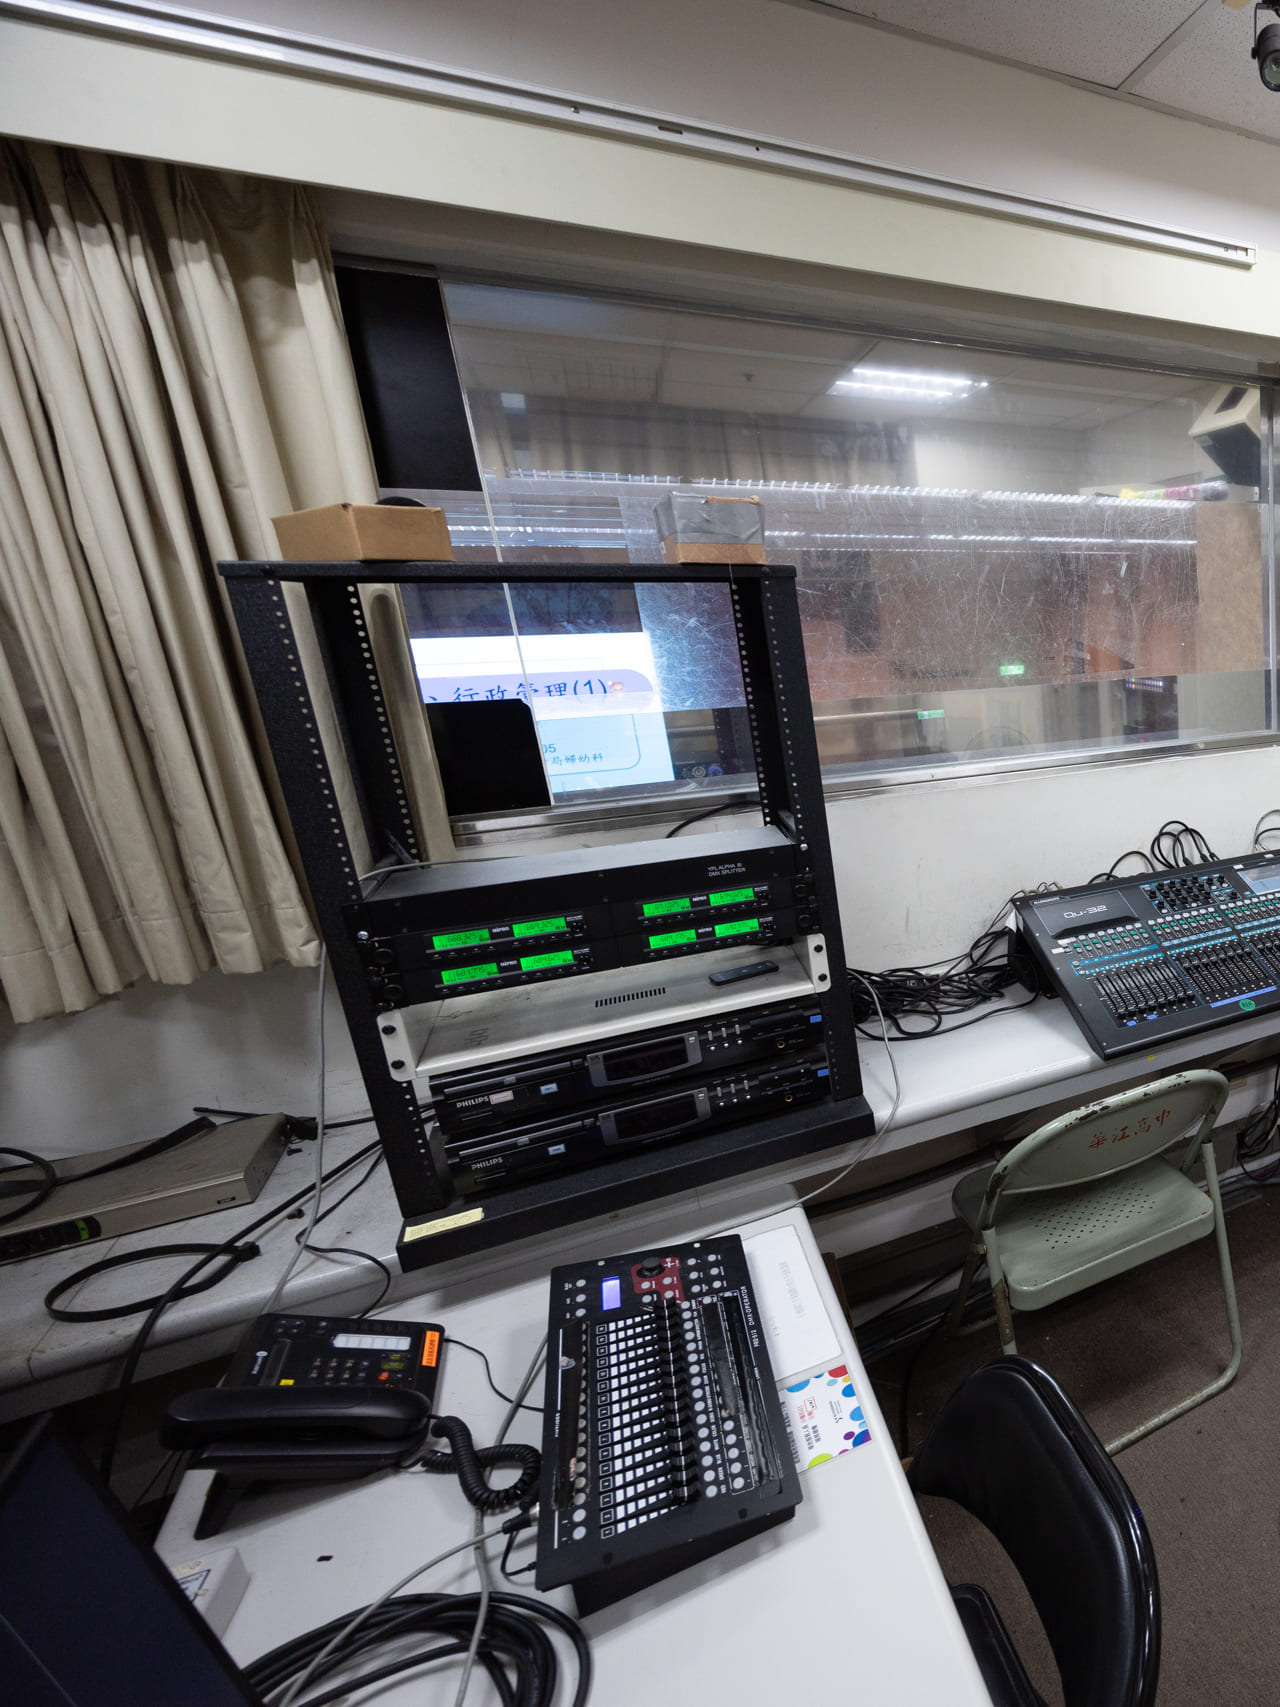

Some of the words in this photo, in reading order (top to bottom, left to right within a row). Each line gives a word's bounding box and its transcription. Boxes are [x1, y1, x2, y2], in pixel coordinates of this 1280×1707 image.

[1063, 904, 1108, 918] Qu-32
[456, 1095, 489, 1108] PHILIPS
[471, 1156, 504, 1170] PHILIPS
[710, 1425, 718, 1438] COLOR
